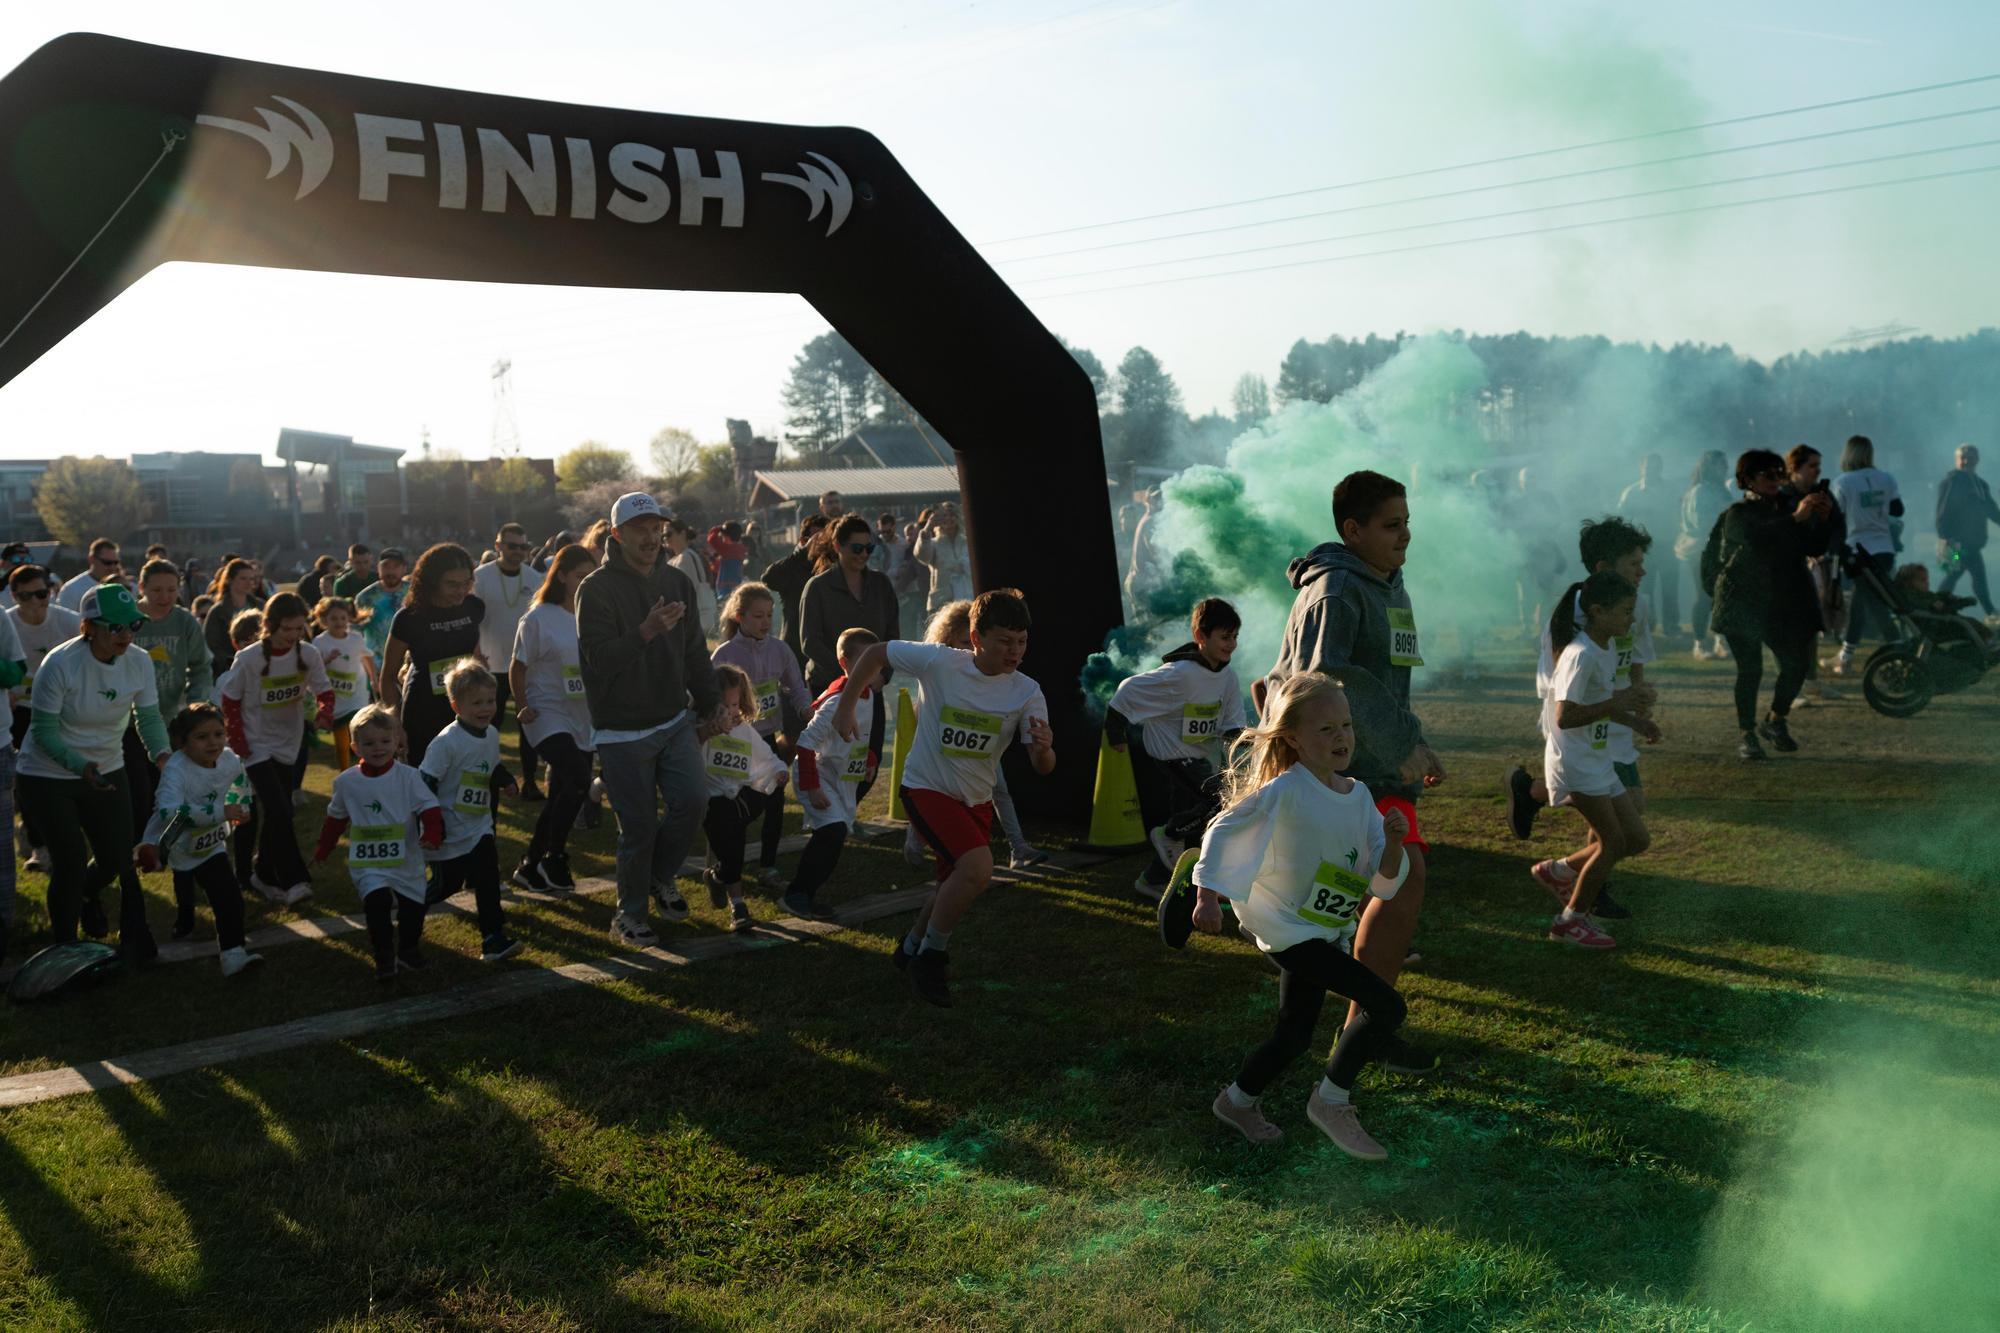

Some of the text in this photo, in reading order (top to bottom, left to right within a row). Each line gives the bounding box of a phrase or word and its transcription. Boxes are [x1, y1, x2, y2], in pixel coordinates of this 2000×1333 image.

[354, 112, 745, 228] FINISH
[266, 685, 300, 702] 8099
[759, 695, 776, 710] 32
[941, 727, 991, 751] 8067
[713, 752, 748, 770] 8226
[195, 827, 226, 850] 8216
[356, 842, 399, 858] 8183
